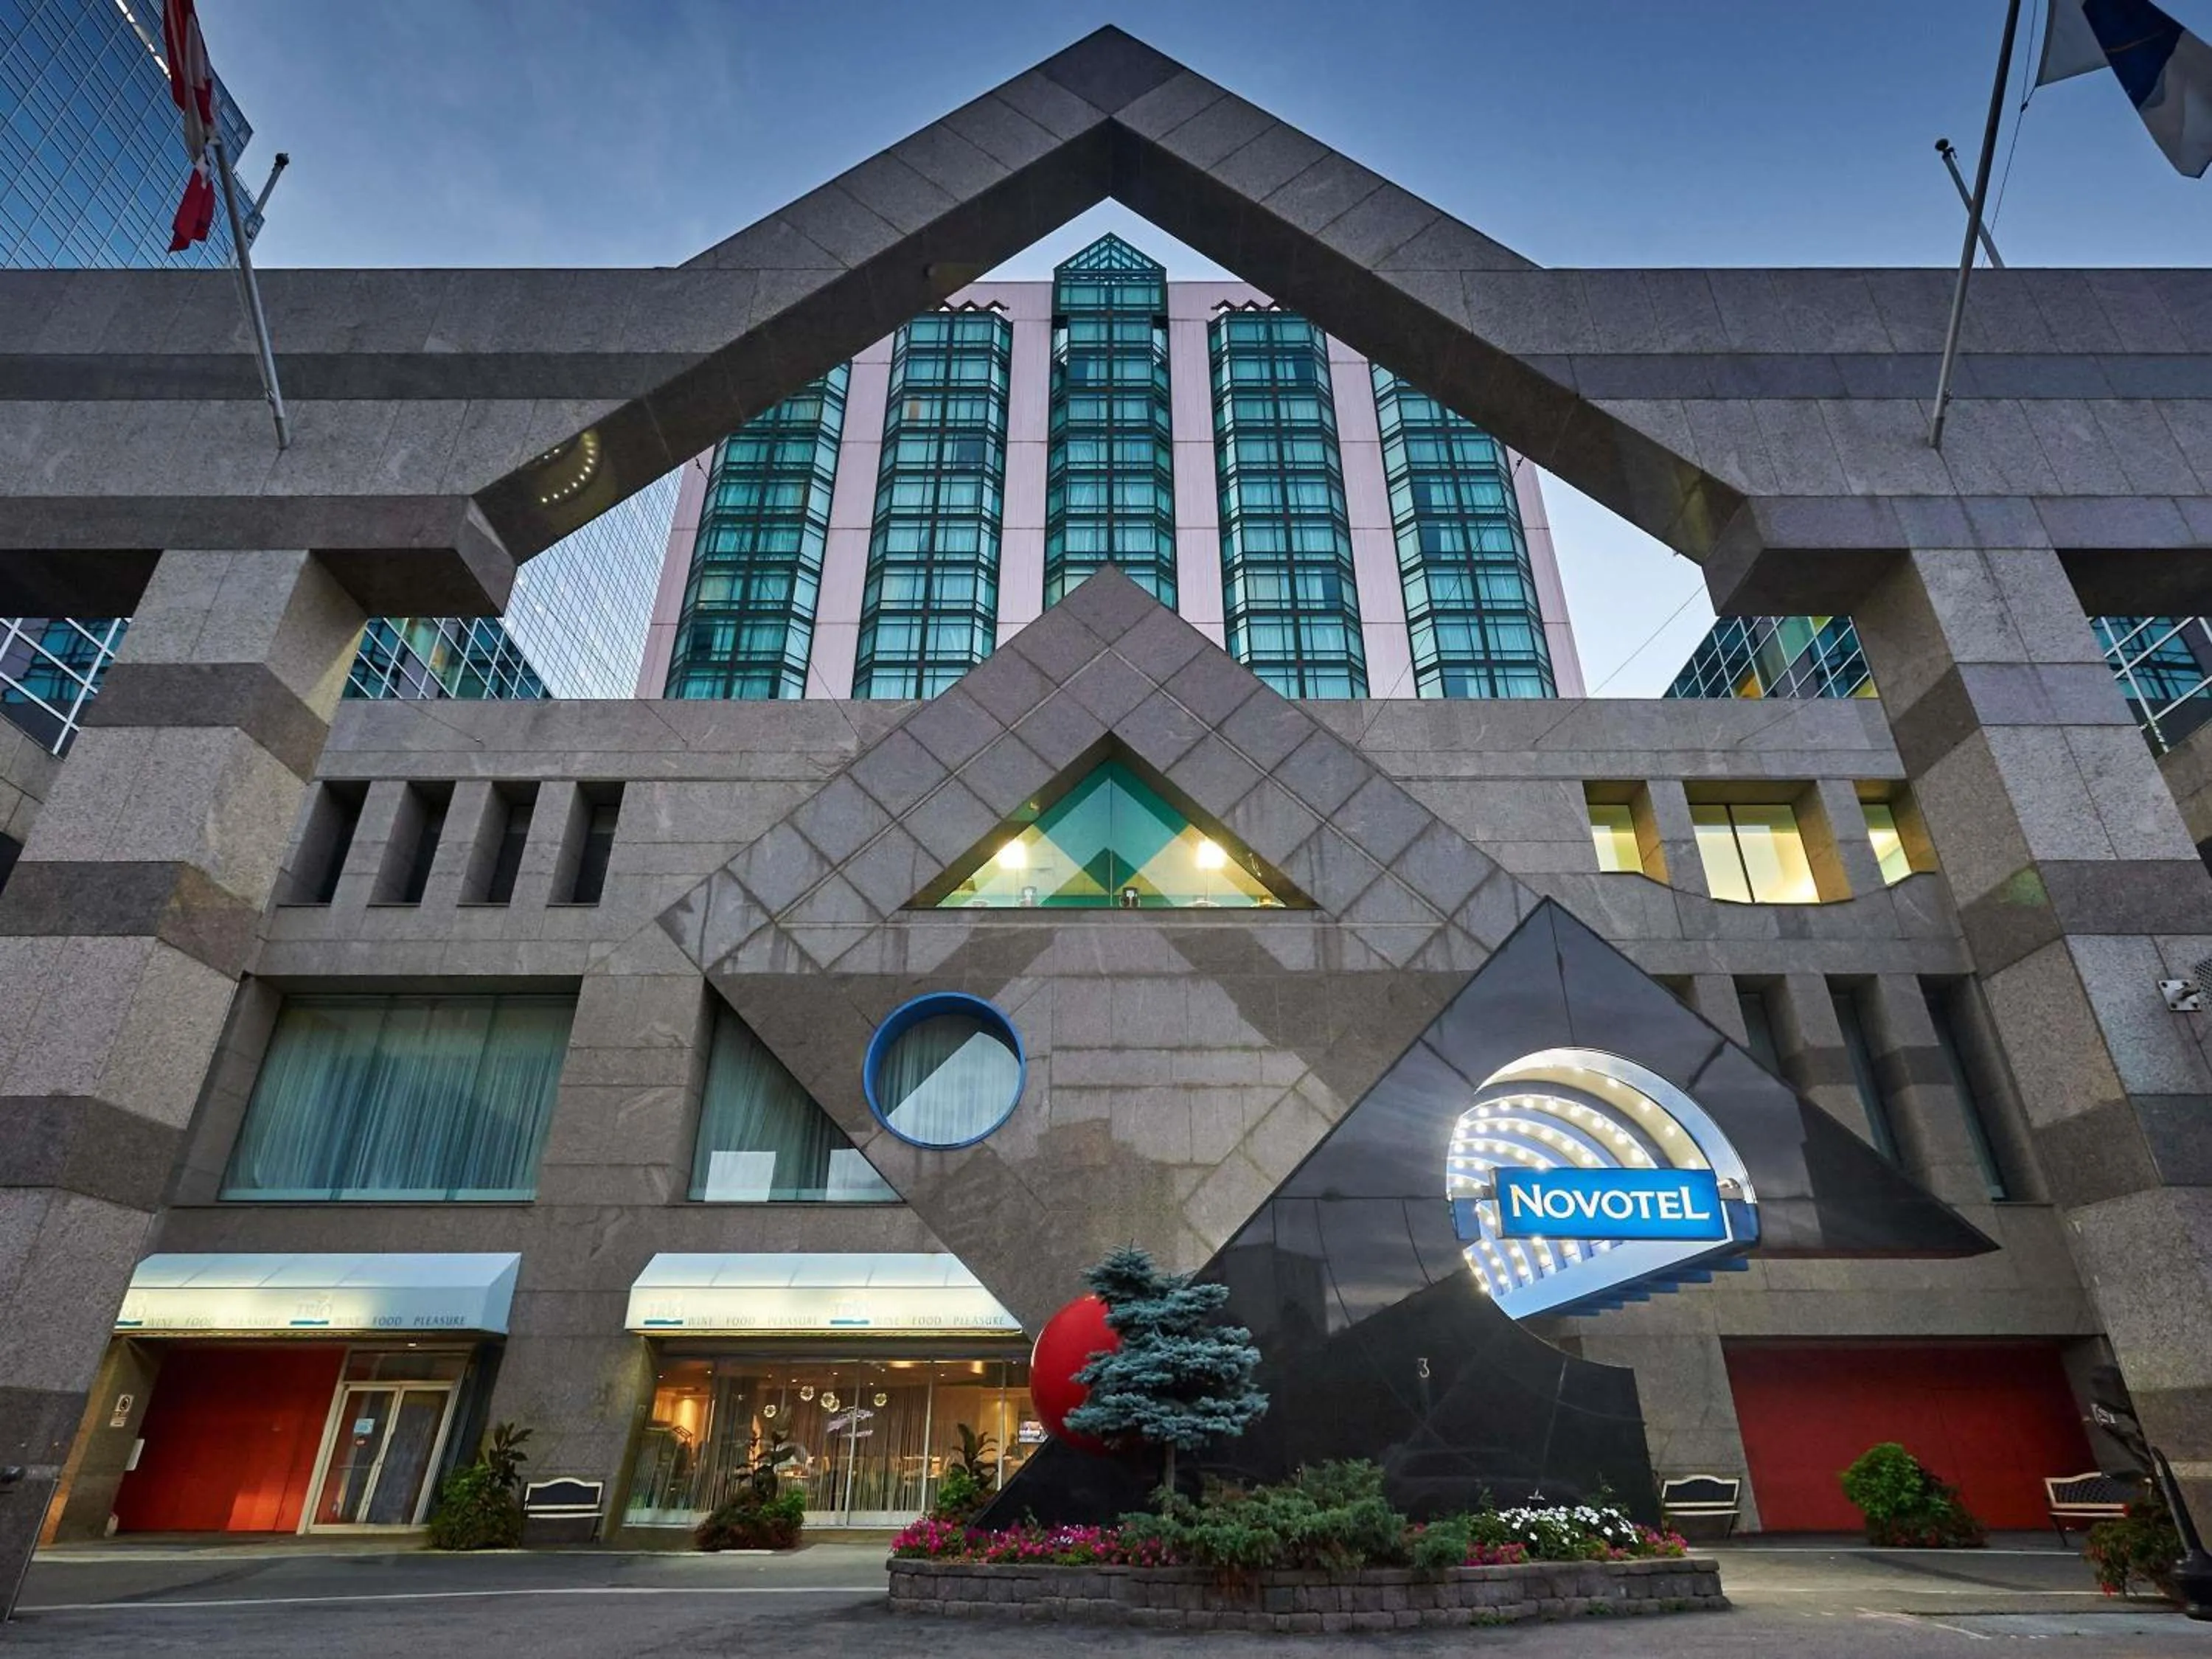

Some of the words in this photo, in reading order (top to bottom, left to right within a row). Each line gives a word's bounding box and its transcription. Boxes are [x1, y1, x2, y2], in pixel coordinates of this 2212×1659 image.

[1509, 1183, 1710, 1220] NOVOTEL
[185, 1317, 215, 1326] FOOD
[228, 1317, 279, 1326] PLEASURE
[372, 1316, 403, 1326] FOOD
[413, 1315, 466, 1326] PLEASURE
[725, 1316, 756, 1326] FOOD
[768, 1316, 818, 1326] PLEASURE
[912, 1316, 942, 1326] FOOD
[953, 1316, 1005, 1326] PLEASURE
[1416, 1357, 1430, 1379] 3
